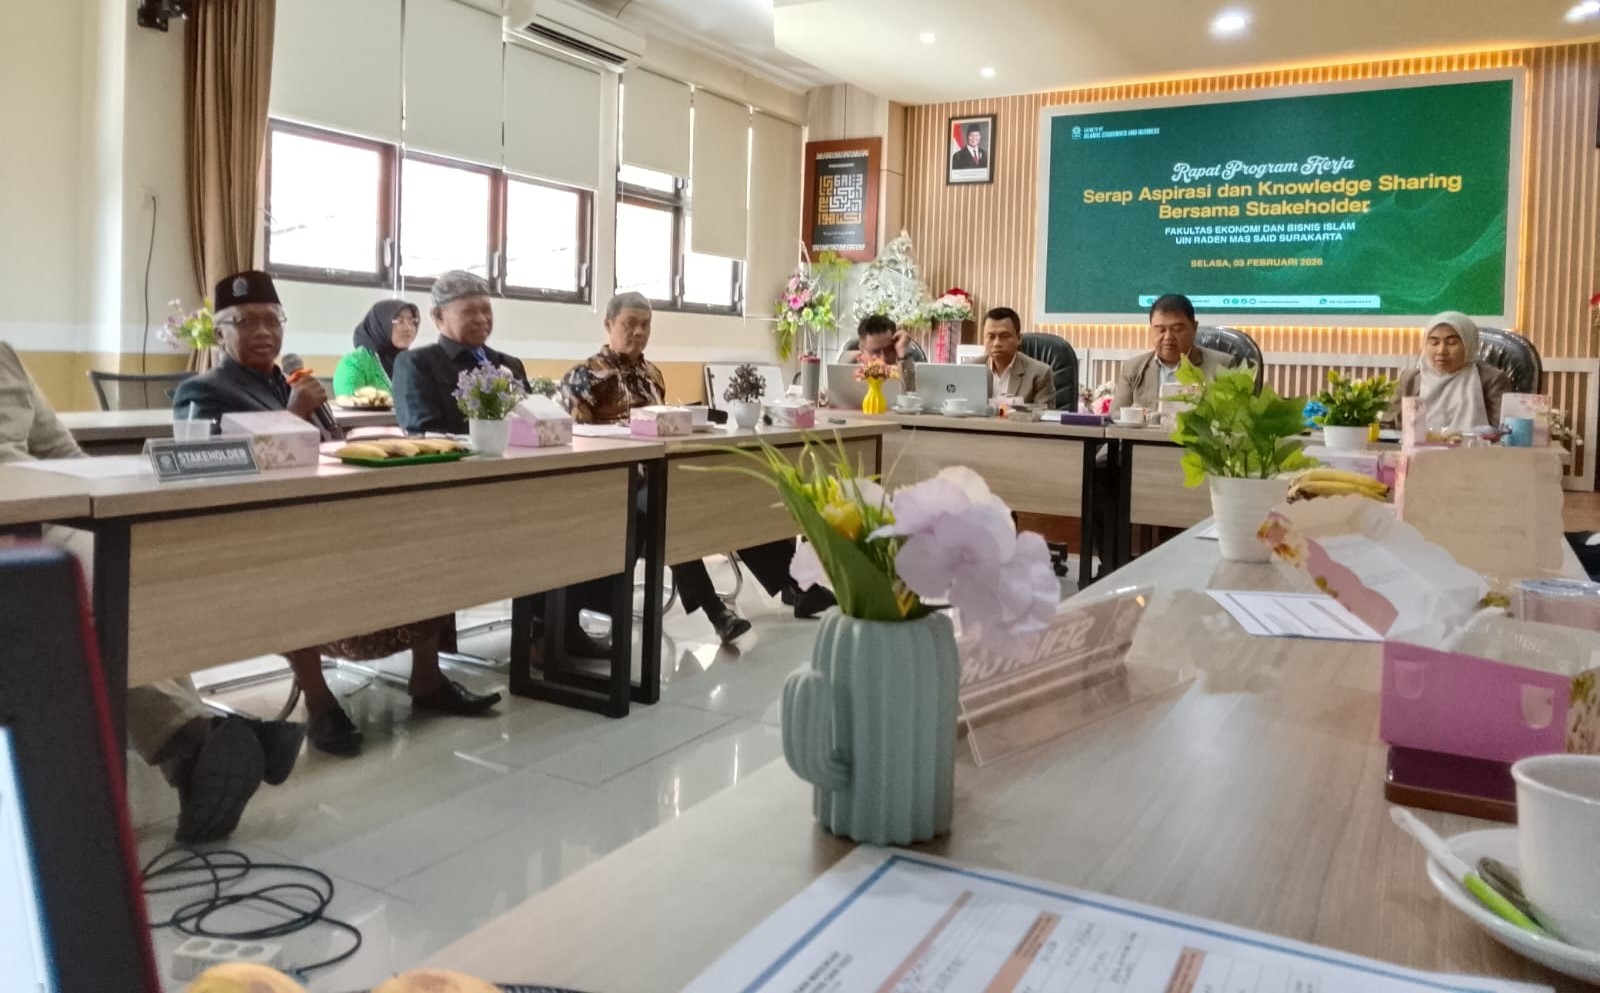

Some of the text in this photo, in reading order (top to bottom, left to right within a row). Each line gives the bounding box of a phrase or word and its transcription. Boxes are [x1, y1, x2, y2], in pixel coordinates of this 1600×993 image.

[1171, 155, 1355, 183] Rapat Program Kerja
[1083, 173, 1462, 206] Serap Aspirasi dan Knowledge Sharing
[1159, 198, 1371, 219] Bersama Stakeholder
[1164, 221, 1356, 236] FAKULTAS EKONOMI DAN BISNIS ISLAM
[1175, 232, 1343, 245] UIN RADEN MAS SAID SURAKARTA
[1190, 259, 1232, 268] SELASA,
[1247, 257, 1298, 267] FEBRUARI
[1299, 257, 1323, 266] 2026
[177, 448, 248, 465] STAKEHOLDER
